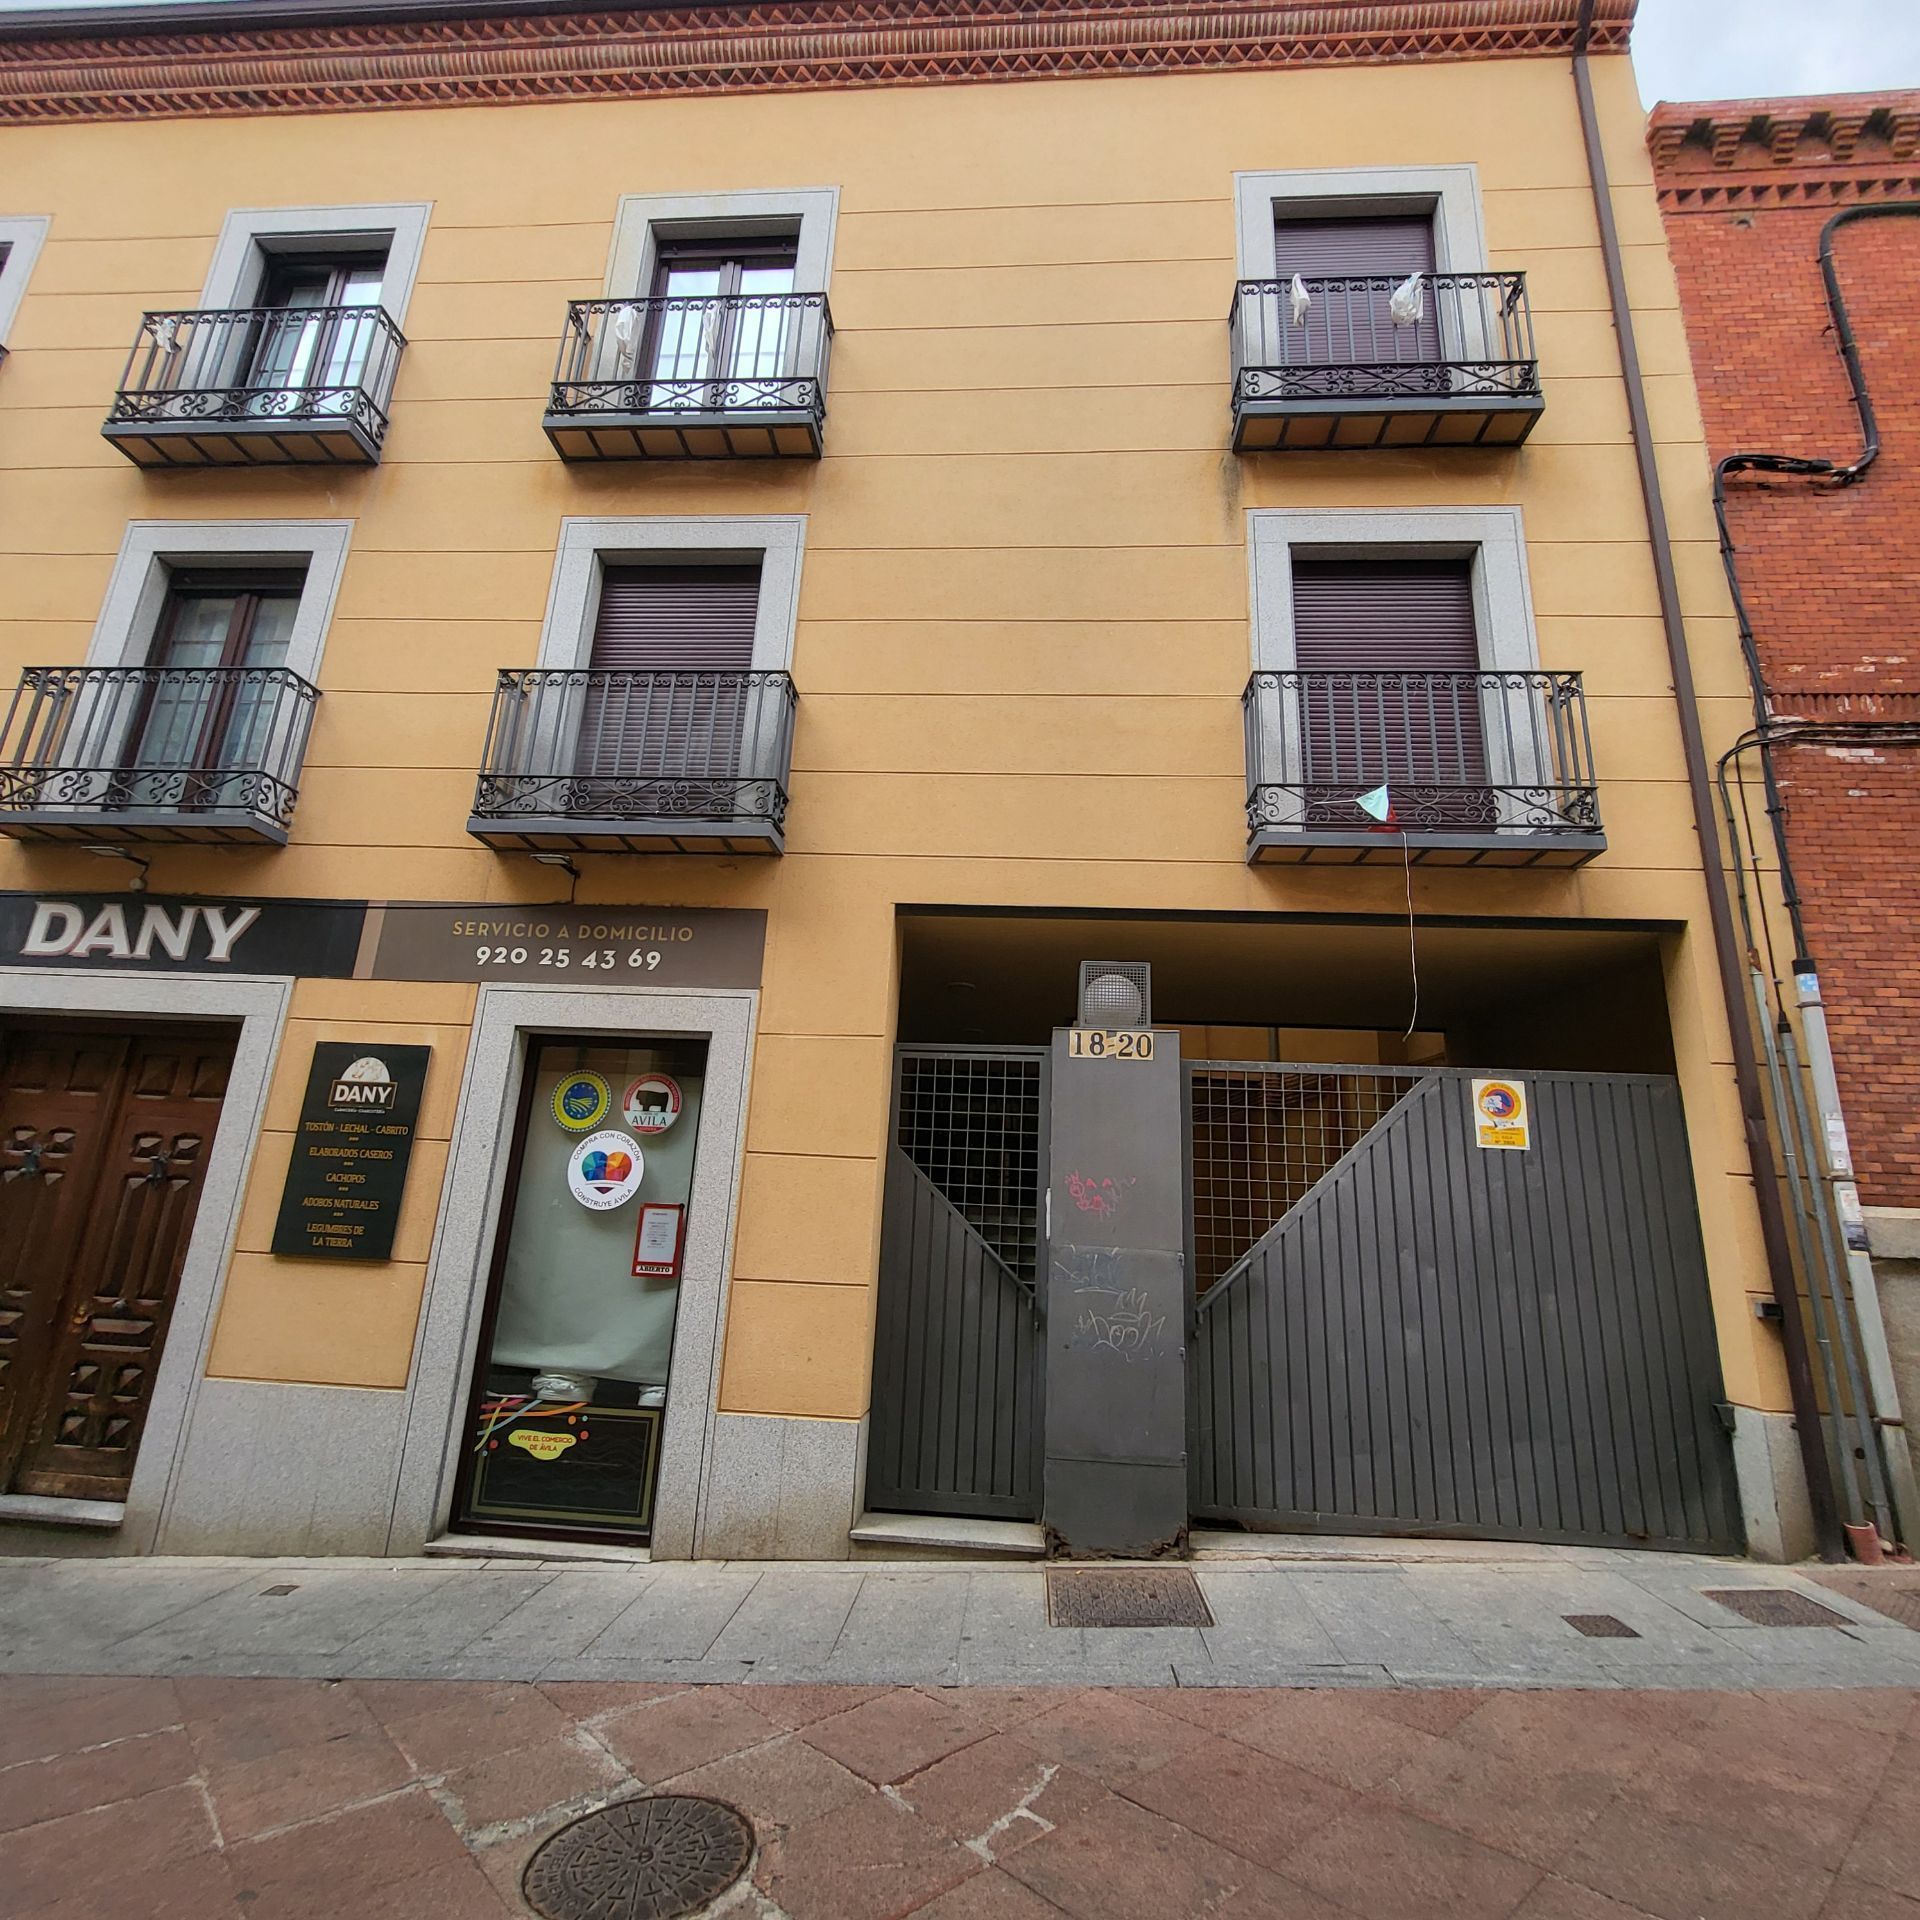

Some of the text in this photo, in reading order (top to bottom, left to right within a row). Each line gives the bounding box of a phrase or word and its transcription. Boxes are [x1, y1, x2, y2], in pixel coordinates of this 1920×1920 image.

[19, 901, 262, 962] DANY
[452, 921, 694, 942] SERVICIO A DOMICILIO
[476, 946, 662, 971] 920 25 43 69
[1074, 1031, 1152, 1059] 18-20
[334, 1084, 392, 1104] DANY
[340, 1123, 370, 1134] LECHAL
[375, 1125, 409, 1135] CABRITO
[309, 1146, 393, 1160] ELABORADOS CASEROS
[573, 1135, 598, 1160] COMPRA
[325, 1172, 367, 1184] CACHOPOS
[302, 1197, 380, 1210] ADOBOS NATURALES
[574, 1187, 612, 1207] CONSTRUYE
[306, 1223, 365, 1235] LEGUMBRES DE
[312, 1236, 353, 1248] LA TIERRA
[518, 1434, 532, 1442] VIVE
[541, 1436, 573, 1444] COMERCIO
[529, 1443, 537, 1451] DE
